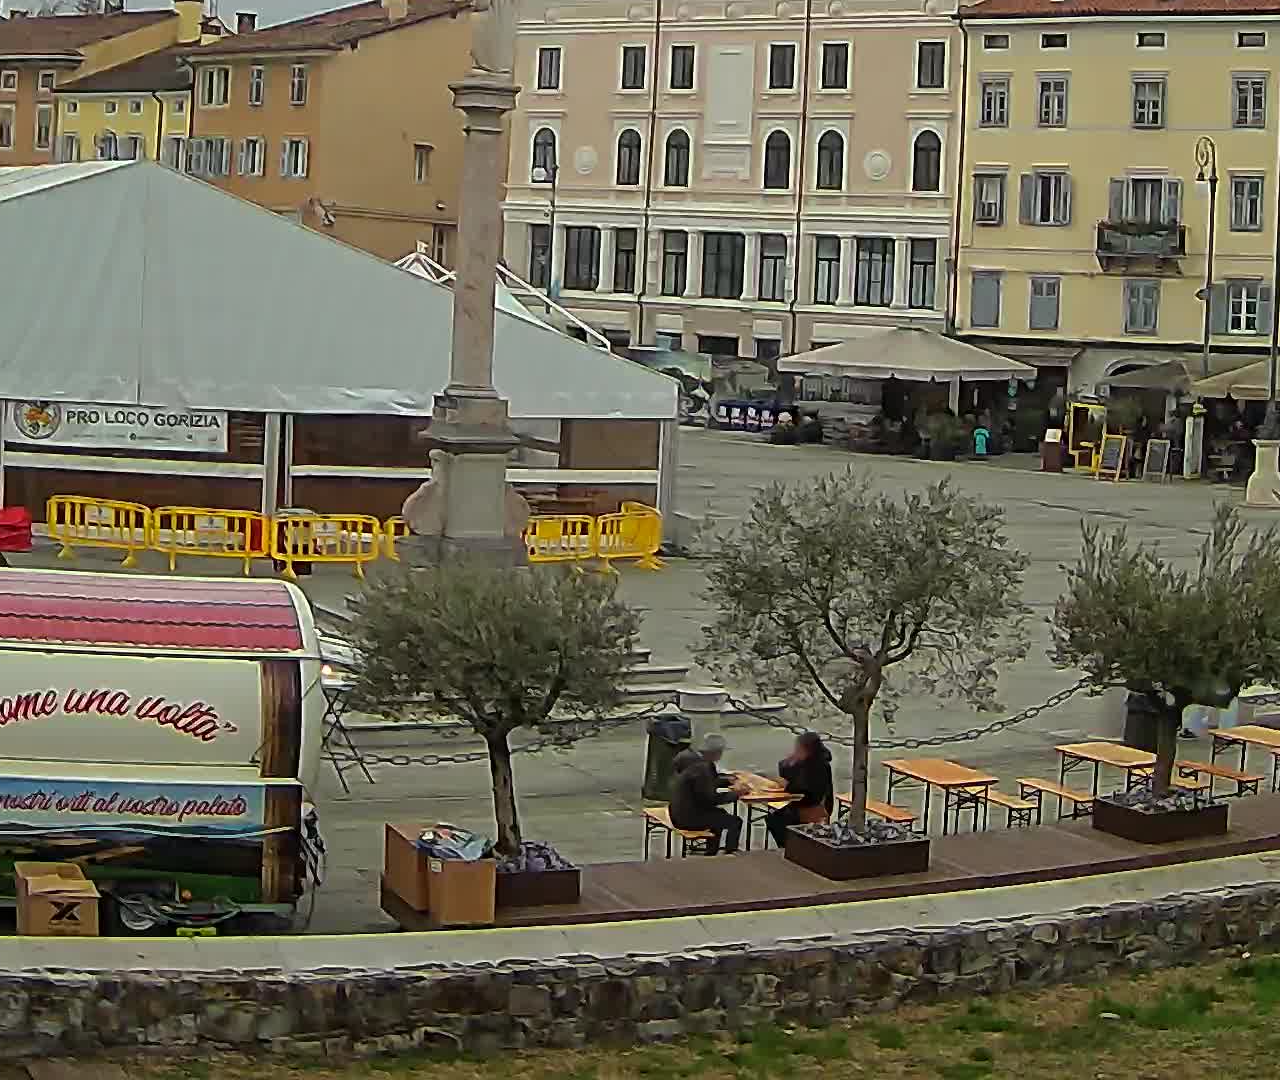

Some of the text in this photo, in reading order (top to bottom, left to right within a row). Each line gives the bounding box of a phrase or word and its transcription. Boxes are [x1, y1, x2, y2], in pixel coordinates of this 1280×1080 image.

[66, 410, 221, 428] PRO LOCO GORIZIA
[63, 687, 132, 717] una
[55, 789, 96, 813] orti
[93, 791, 120, 814] al
[117, 794, 180, 817] vostro
[176, 792, 248, 823] palato
